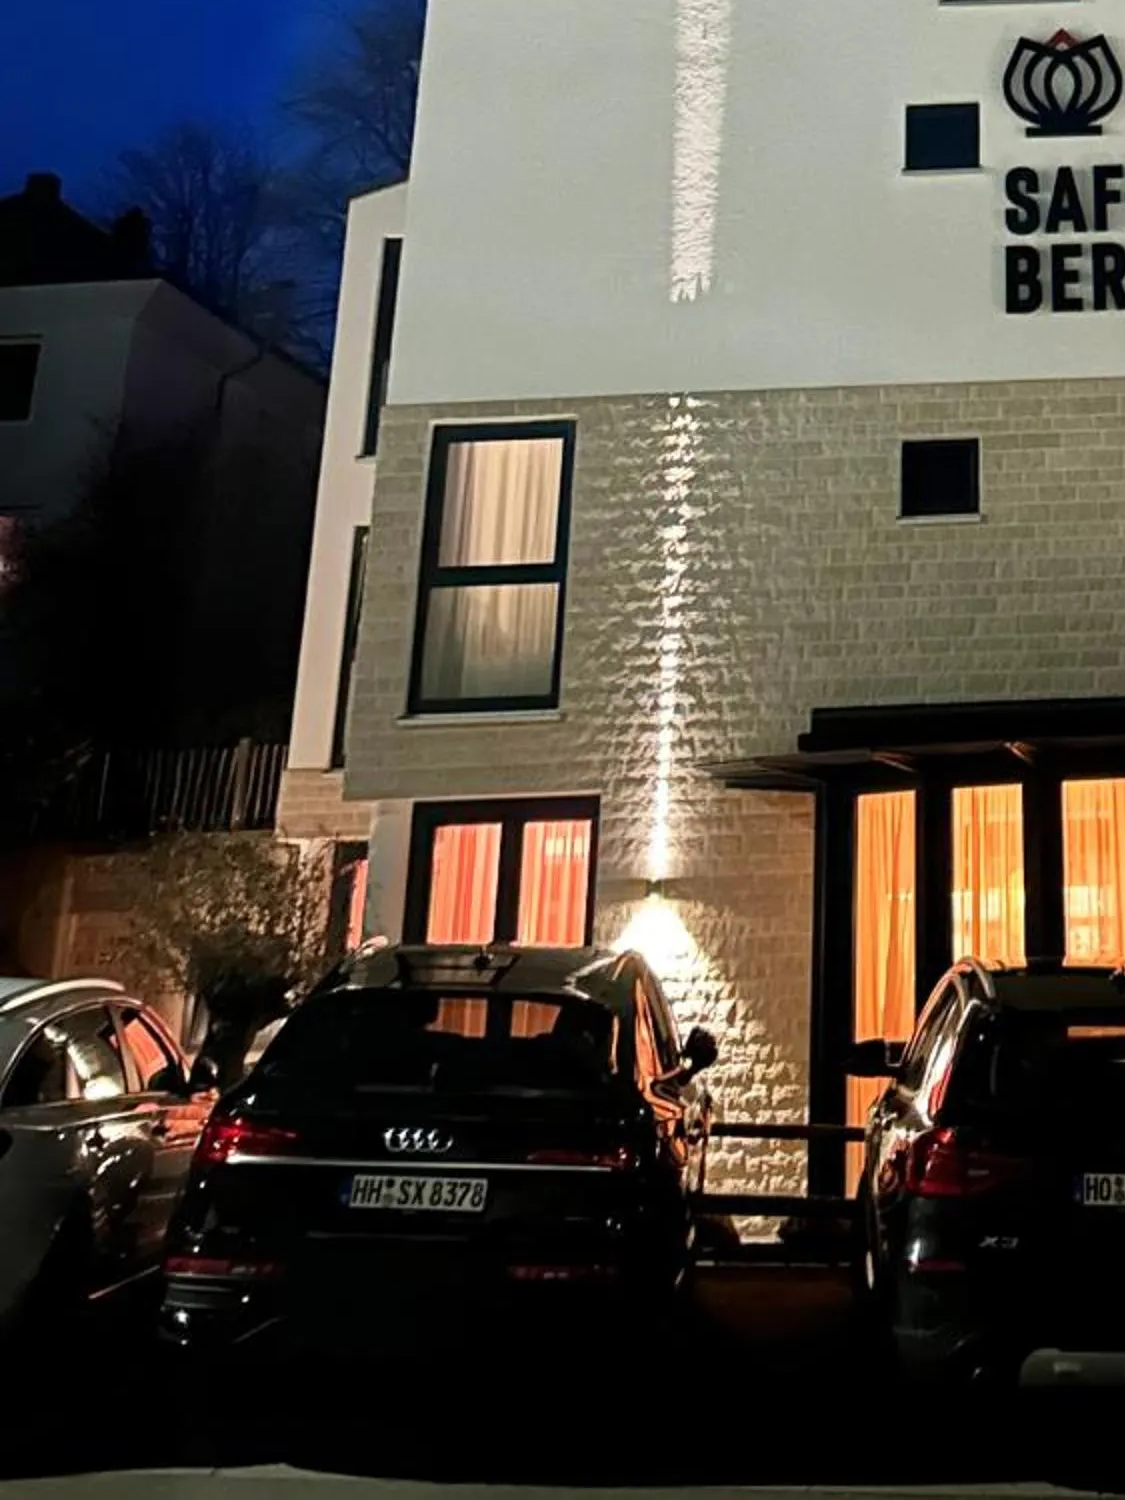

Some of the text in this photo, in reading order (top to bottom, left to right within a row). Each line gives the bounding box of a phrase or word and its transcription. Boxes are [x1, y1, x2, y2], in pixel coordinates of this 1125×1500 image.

[352, 1179, 485, 1208] HH SX 8378
[1086, 1177, 1111, 1202] HO
